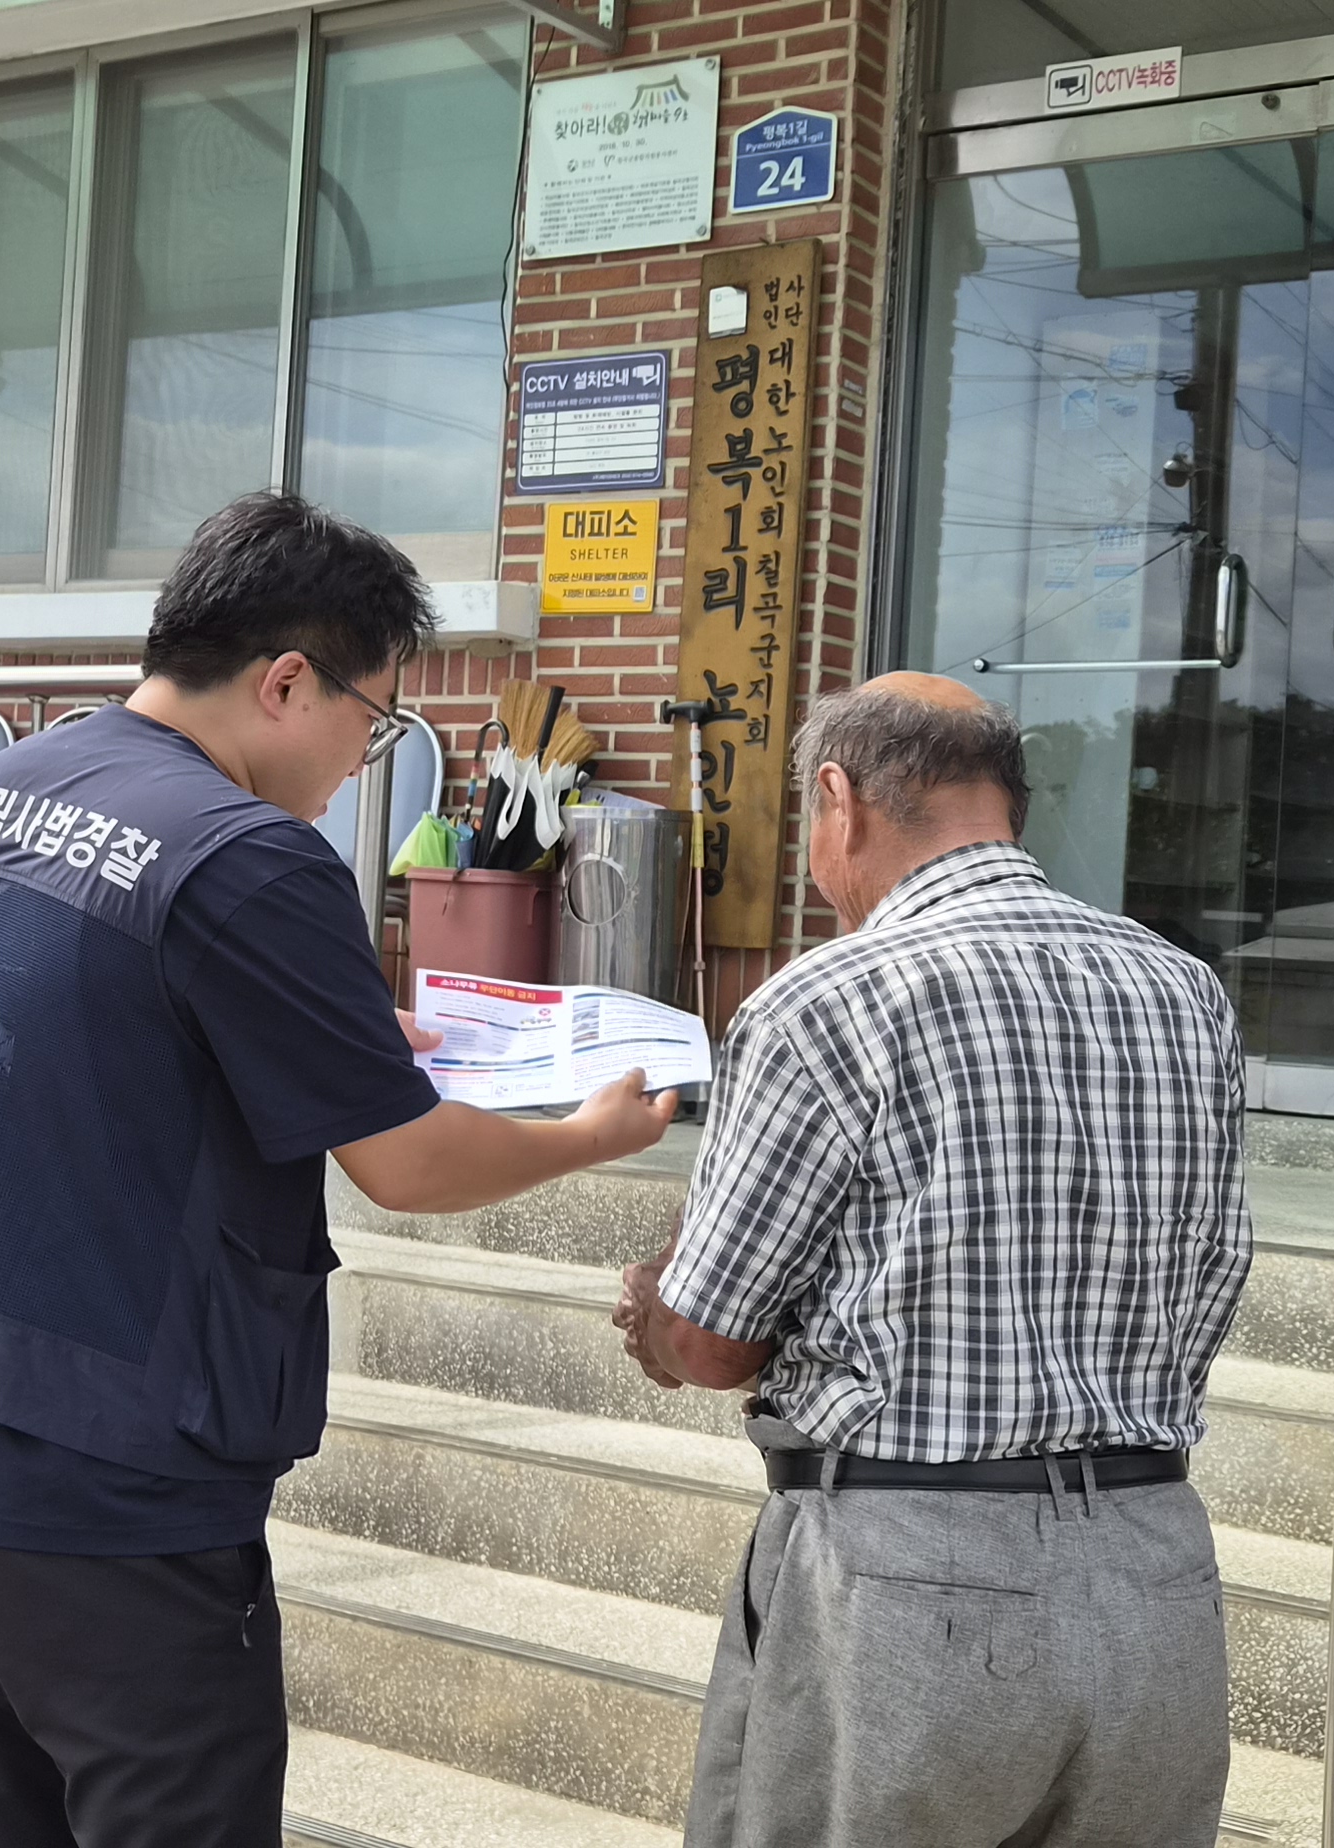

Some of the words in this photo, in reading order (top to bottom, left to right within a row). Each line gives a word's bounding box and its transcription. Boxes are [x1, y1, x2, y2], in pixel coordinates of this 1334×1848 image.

[555, 114, 607, 140] 찾아라!
[763, 119, 808, 140] 평복1길
[746, 136, 799, 152] Pyeongbok
[802, 131, 824, 143] 1-gil
[757, 156, 806, 197] 24
[526, 374, 568, 393] CCTV
[573, 368, 629, 390] 설치안내
[757, 338, 796, 540] 대한노인회
[701, 344, 764, 631] 평복1리
[562, 509, 638, 538] 대피소
[570, 548, 628, 560] SHELTER
[517, 990, 536, 1001] 금지
